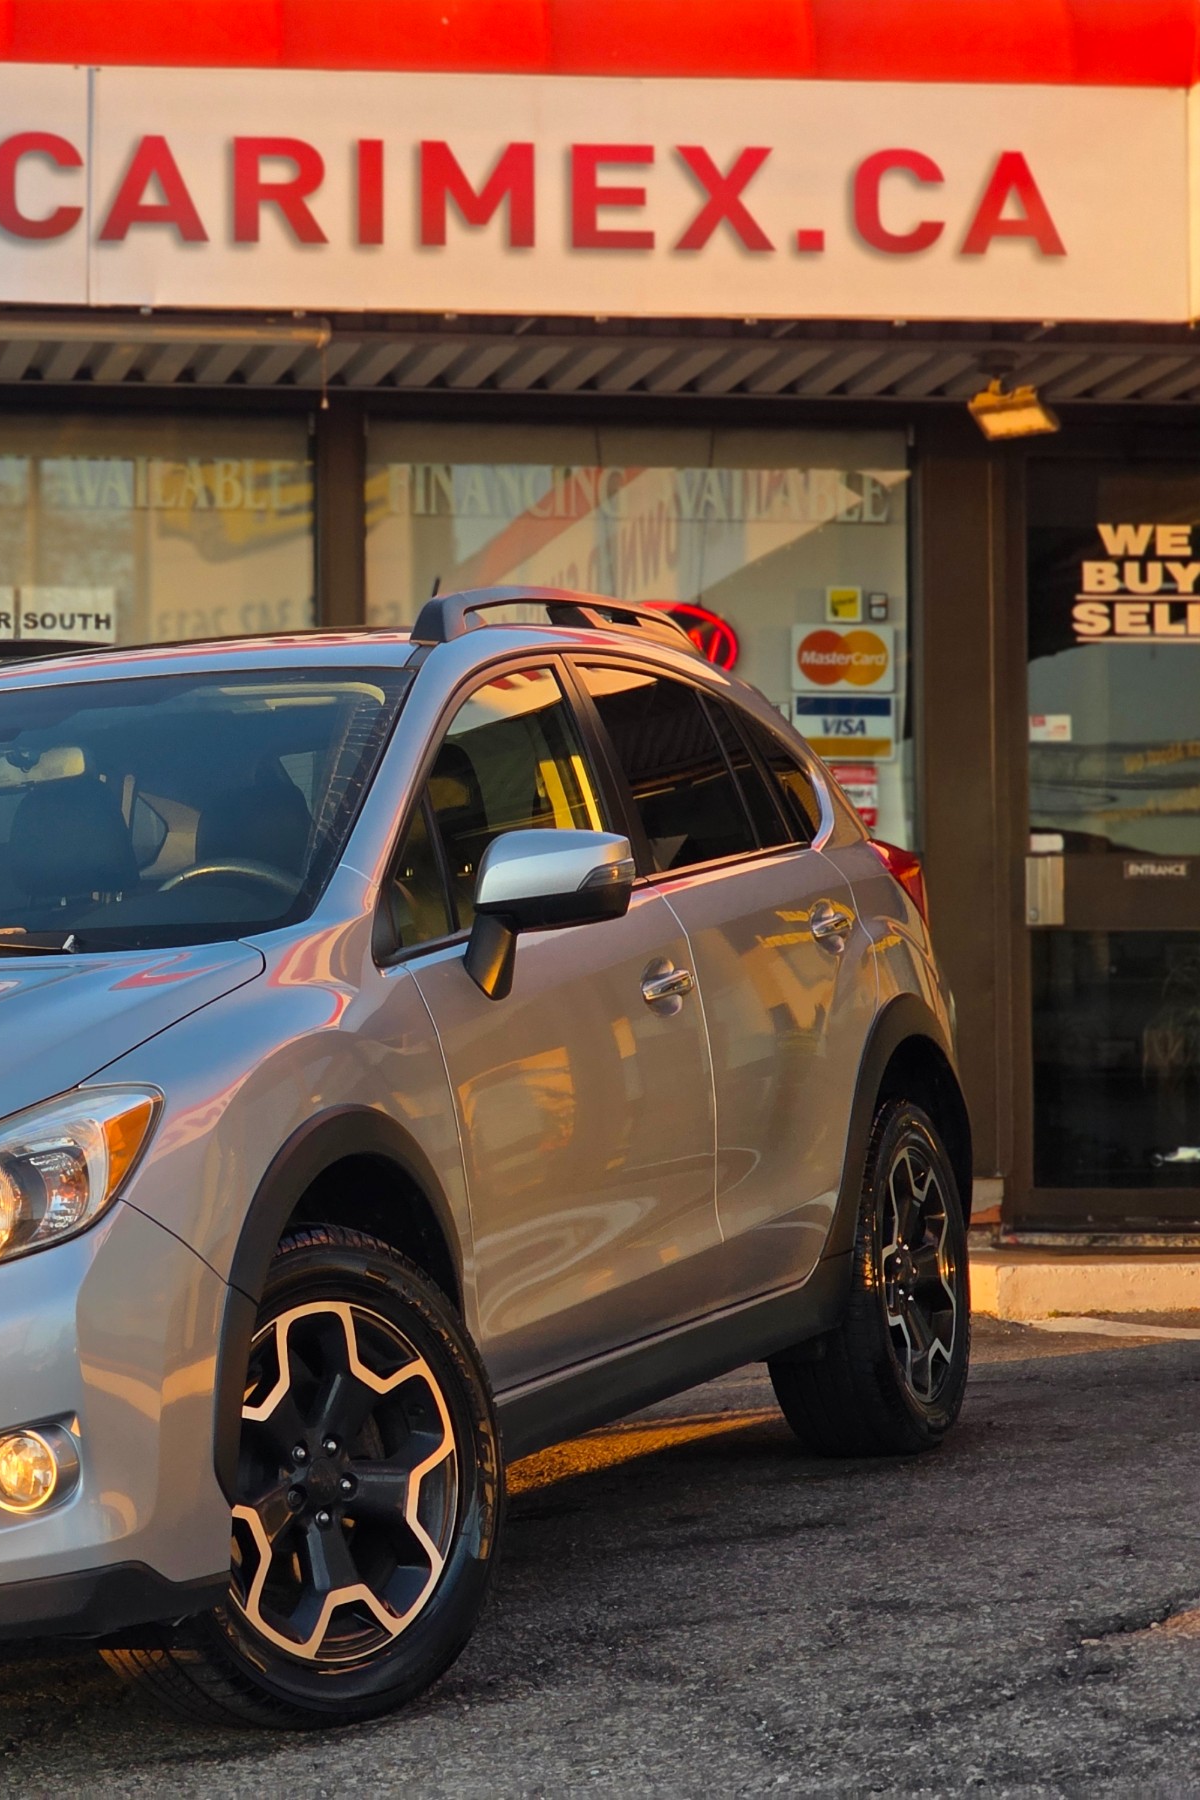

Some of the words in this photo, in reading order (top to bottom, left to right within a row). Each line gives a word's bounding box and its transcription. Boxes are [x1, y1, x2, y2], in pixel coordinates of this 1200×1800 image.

[388, 464, 629, 517] FINANCING
[657, 468, 889, 523] AVAILABLE
[1097, 523, 1192, 556] WE
[1082, 561, 1200, 593] BUY
[23, 612, 111, 630] SOUTH
[801, 650, 886, 666] MasterCard
[821, 718, 867, 735] VISA
[1127, 864, 1186, 875] ENTRANCE
